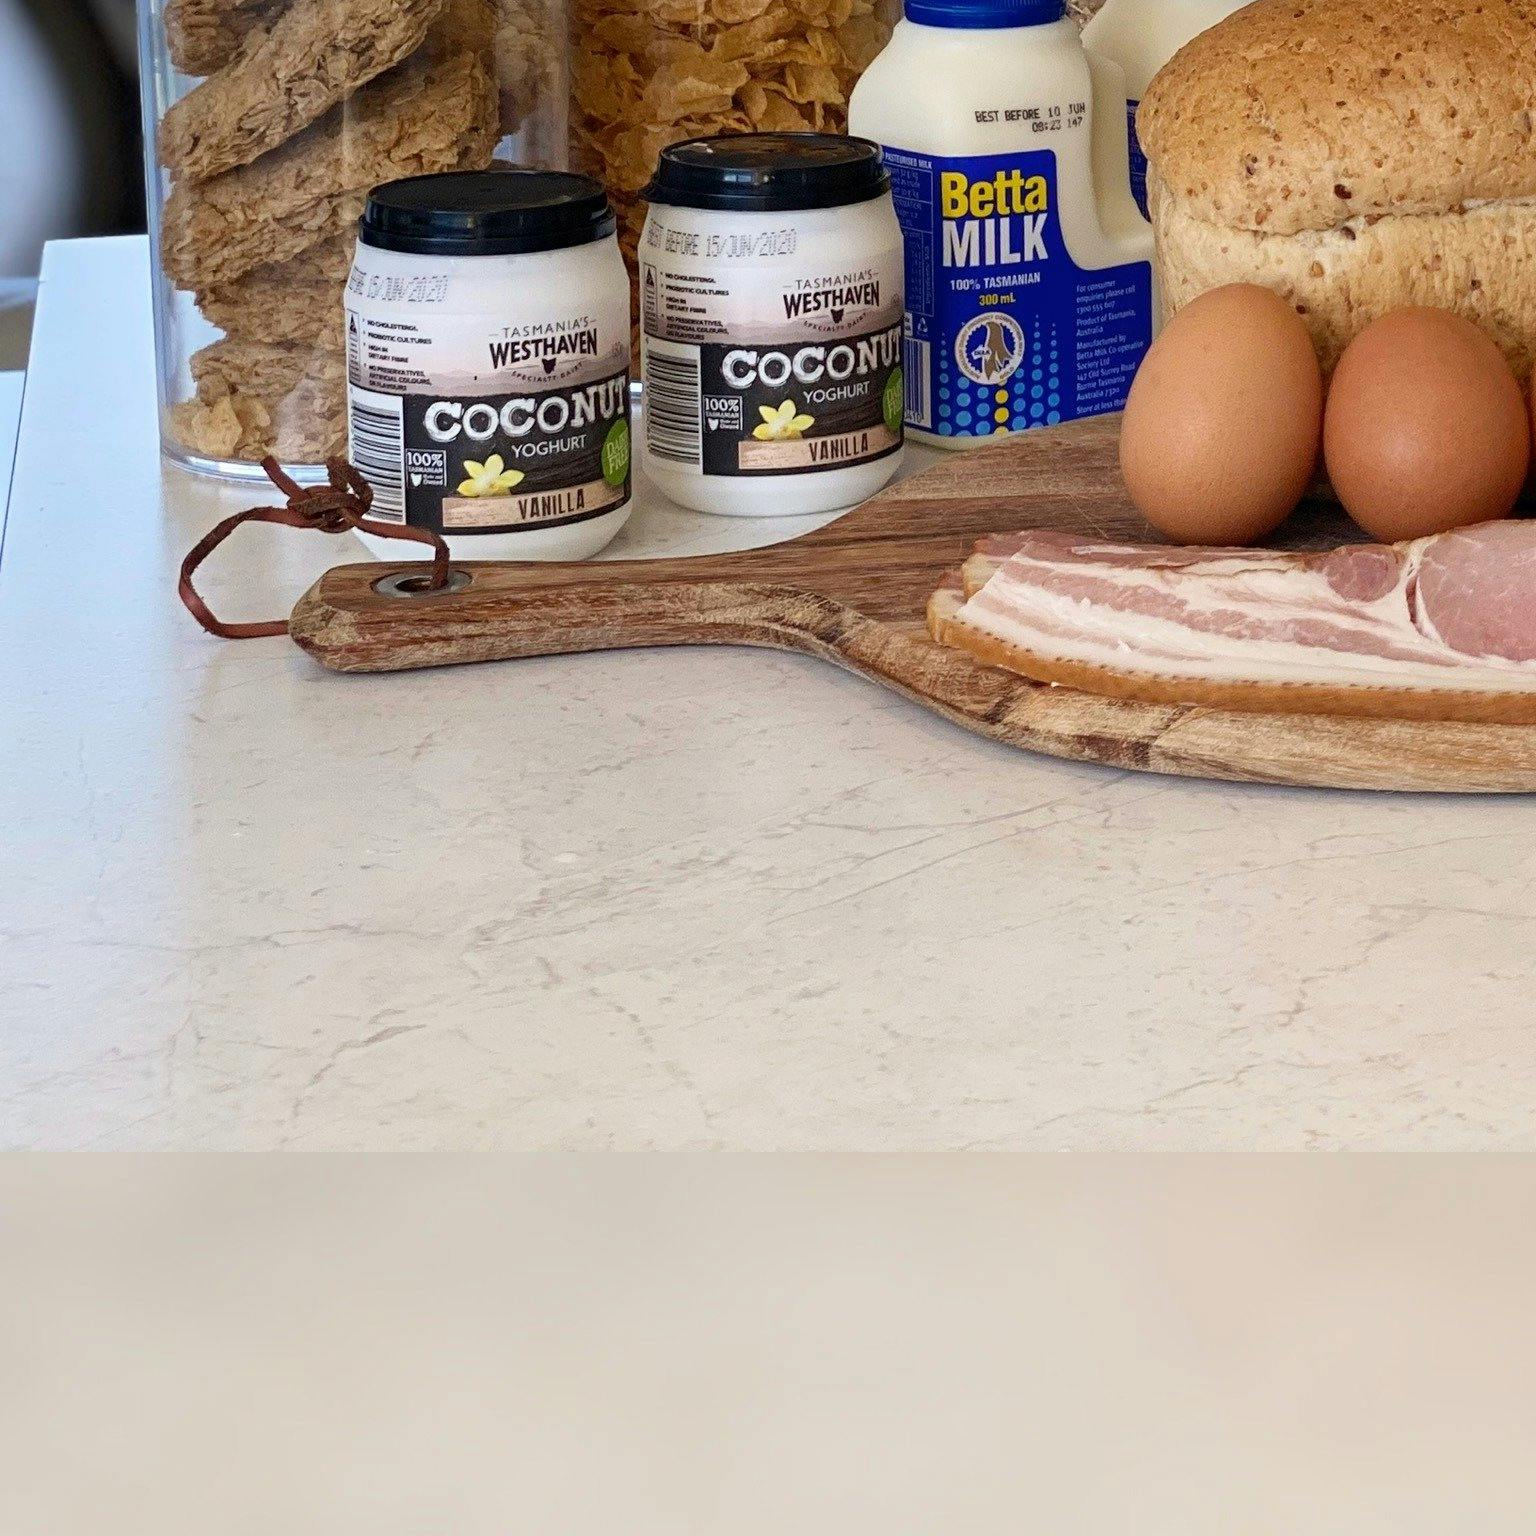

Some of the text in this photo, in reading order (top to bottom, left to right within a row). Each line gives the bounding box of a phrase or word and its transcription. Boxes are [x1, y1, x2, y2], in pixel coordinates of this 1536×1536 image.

[975, 102, 1085, 123] BEST BEFORE 10 JUN
[1032, 119, 1061, 132] 08:23
[940, 169, 1048, 219] Betta
[942, 213, 1049, 268] MILK
[674, 274, 716, 284] CHOLESTEROL
[796, 269, 872, 291] TASMANIA'S
[950, 272, 1041, 291] 100% TASMANIAN
[1076, 280, 1116, 293] For consumer
[665, 284, 730, 296] PROBIOTIC CULTURES
[1076, 292, 1105, 304] enquiries
[1105, 287, 1125, 300] please
[783, 281, 880, 319] WESTHAVEN
[979, 292, 1017, 306] 300 mL
[367, 319, 418, 332] NO CHOLESTEROL
[502, 316, 590, 338] TASMANIA'S
[1076, 317, 1100, 327] Product
[1100, 313, 1107, 322] of
[368, 332, 432, 345] PROBIOTIC CULTURES
[1076, 326, 1104, 337] Australia
[488, 328, 598, 370] WESTHAVEN
[1076, 334, 1127, 351] Manufactured by
[722, 325, 901, 389] COCONUT
[1076, 351, 1094, 361] Betta
[1094, 348, 1108, 358] Milk
[1076, 357, 1110, 371] Society Ltd
[1120, 361, 1136, 372] Road
[1098, 375, 1126, 387] Tasmania
[803, 380, 870, 404] YOGHURT
[1076, 389, 1104, 401] Australia
[423, 375, 627, 443] COCONUT
[705, 397, 739, 412] 100%
[1076, 404, 1093, 415] Store
[511, 434, 587, 459] YOGHURT
[808, 432, 869, 462] VANILLA
[407, 451, 443, 467] 100%
[518, 488, 586, 520] VANILLA
